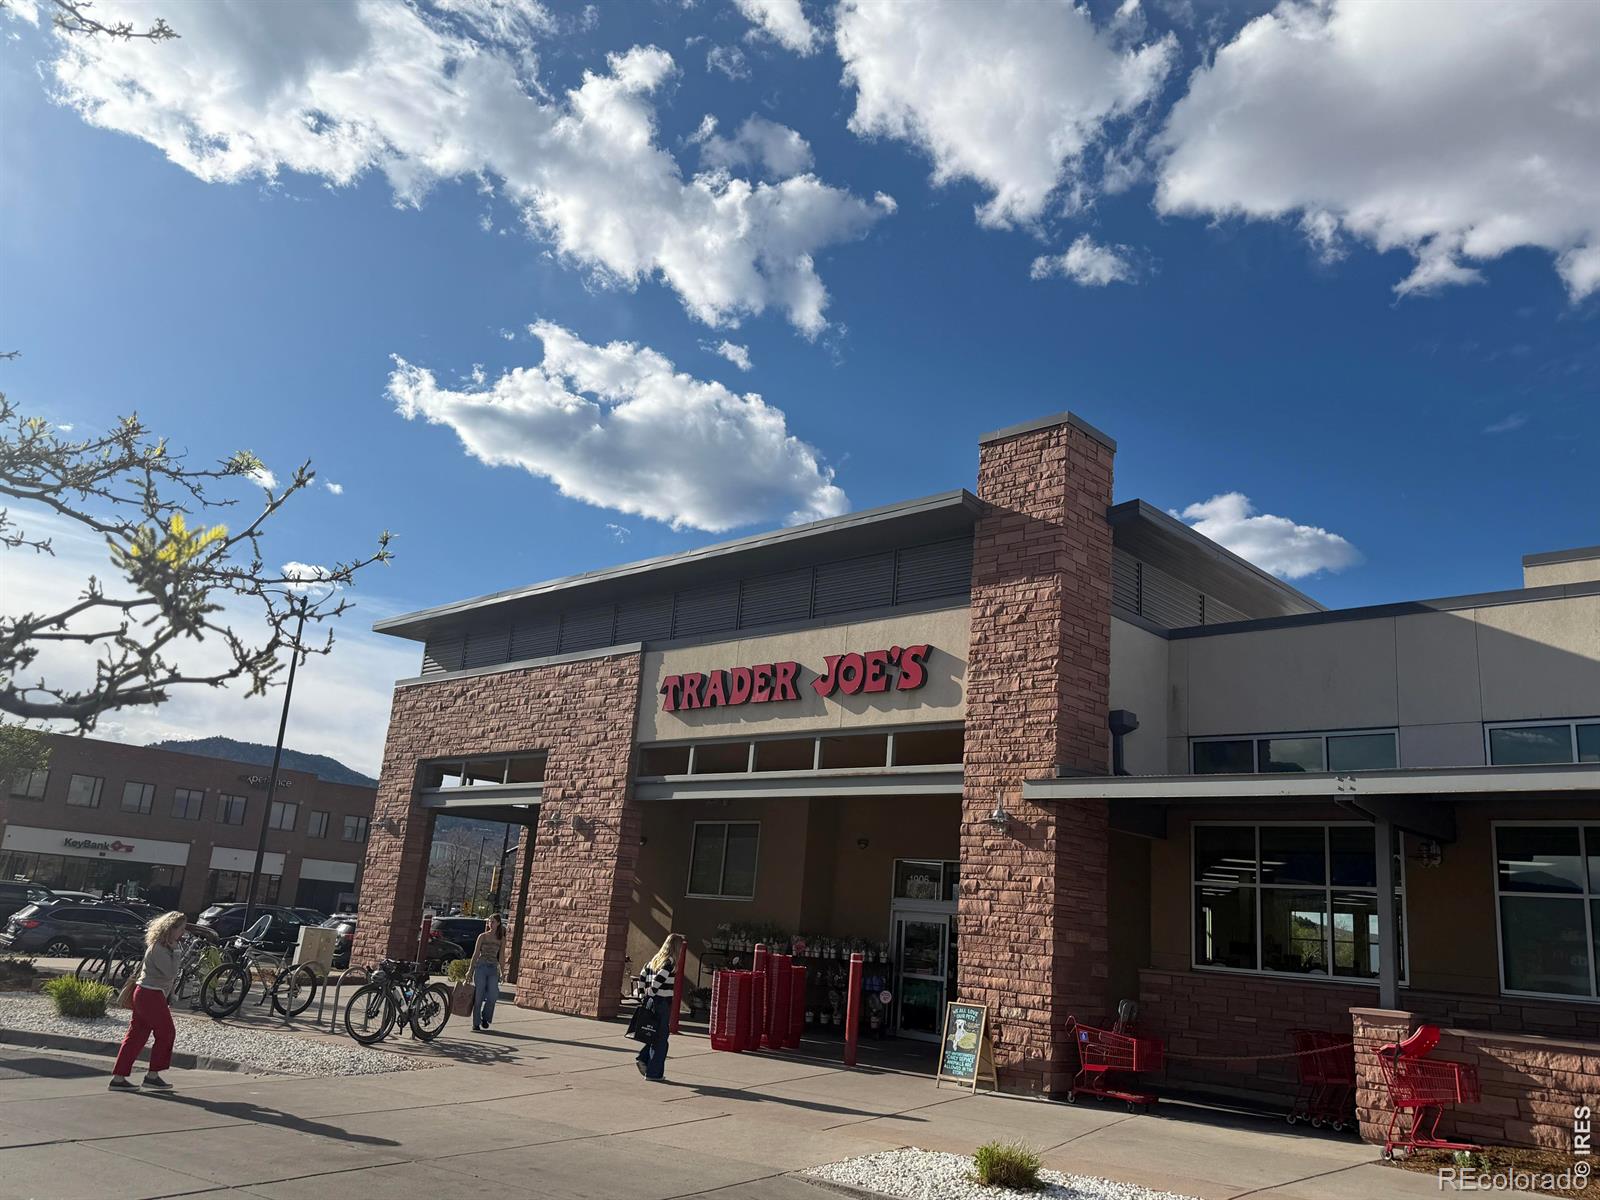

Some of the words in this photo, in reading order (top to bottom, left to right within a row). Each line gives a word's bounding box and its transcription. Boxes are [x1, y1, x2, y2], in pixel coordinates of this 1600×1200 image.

[661, 661, 801, 712] TRADER
[811, 644, 933, 698] JOE'S
[64, 838, 110, 851] KeyBank
